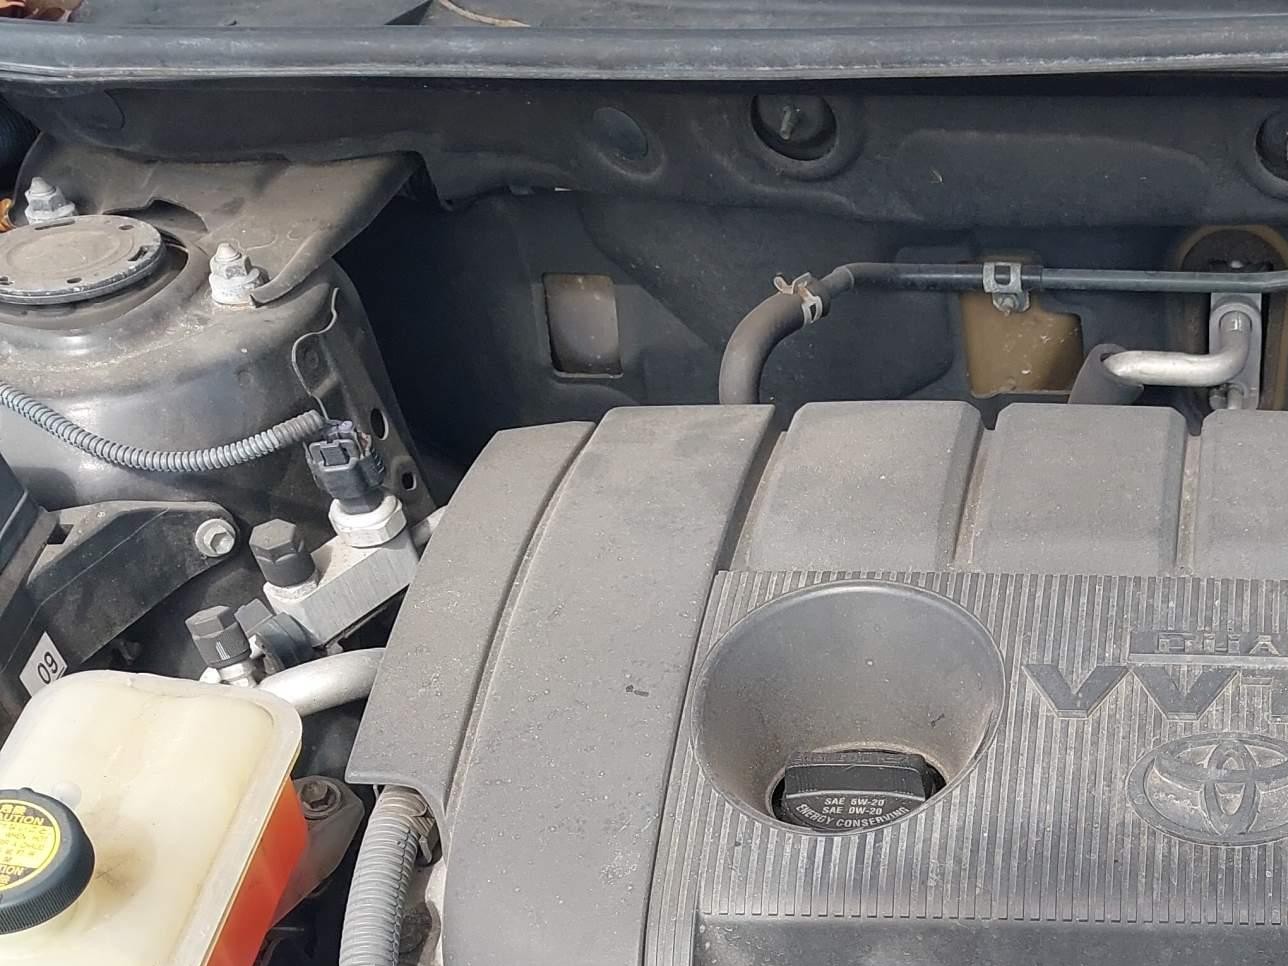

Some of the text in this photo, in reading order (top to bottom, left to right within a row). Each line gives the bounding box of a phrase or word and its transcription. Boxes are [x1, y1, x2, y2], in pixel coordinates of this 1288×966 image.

[824, 797, 885, 807] SAE 5W-20
[795, 803, 835, 825] ENERGY
[822, 806, 883, 816] SAE 0W-20
[0, 813, 45, 826] AUTION
